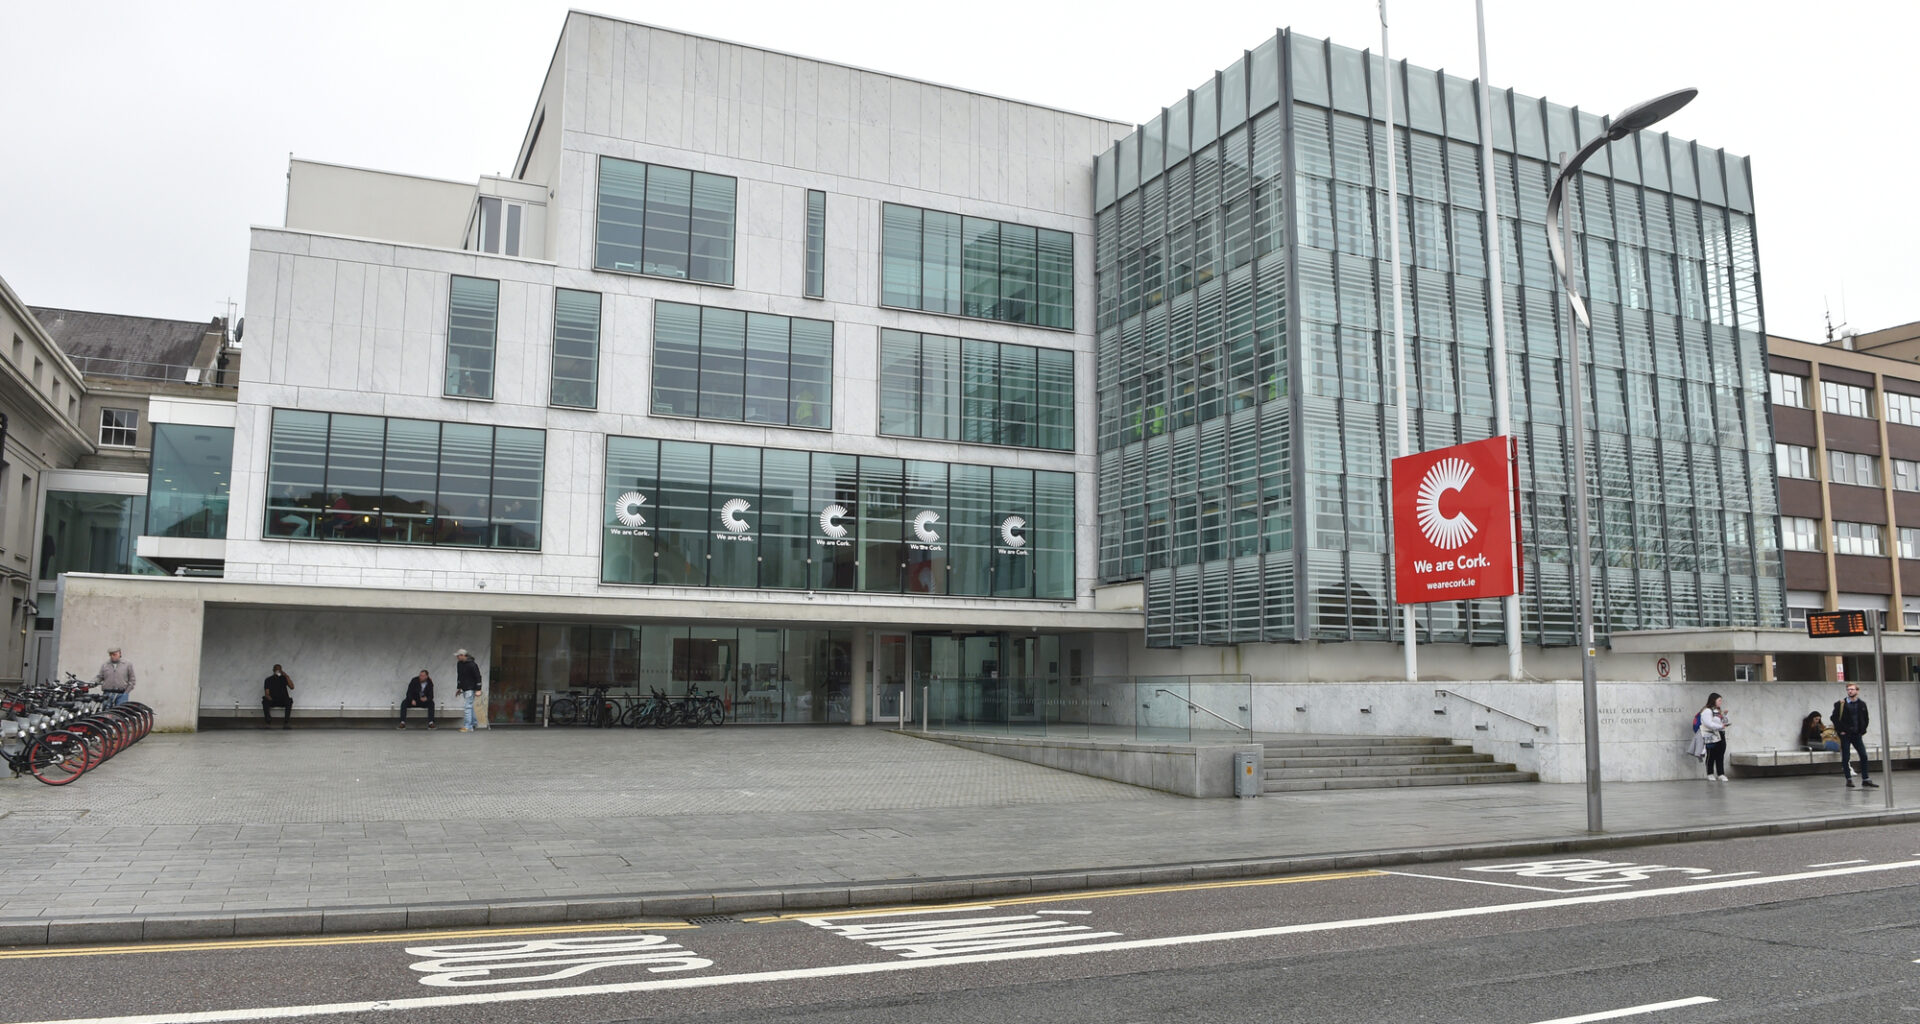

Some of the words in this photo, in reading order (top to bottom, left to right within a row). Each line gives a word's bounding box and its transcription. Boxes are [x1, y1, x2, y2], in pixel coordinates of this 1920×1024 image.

[1413, 559, 1433, 574] We
[1435, 560, 1455, 572] are
[1457, 552, 1491, 569] Cork.
[1426, 577, 1476, 590] wearecork.ie
[1460, 858, 1712, 883] BUS
[405, 934, 714, 987] BUS
